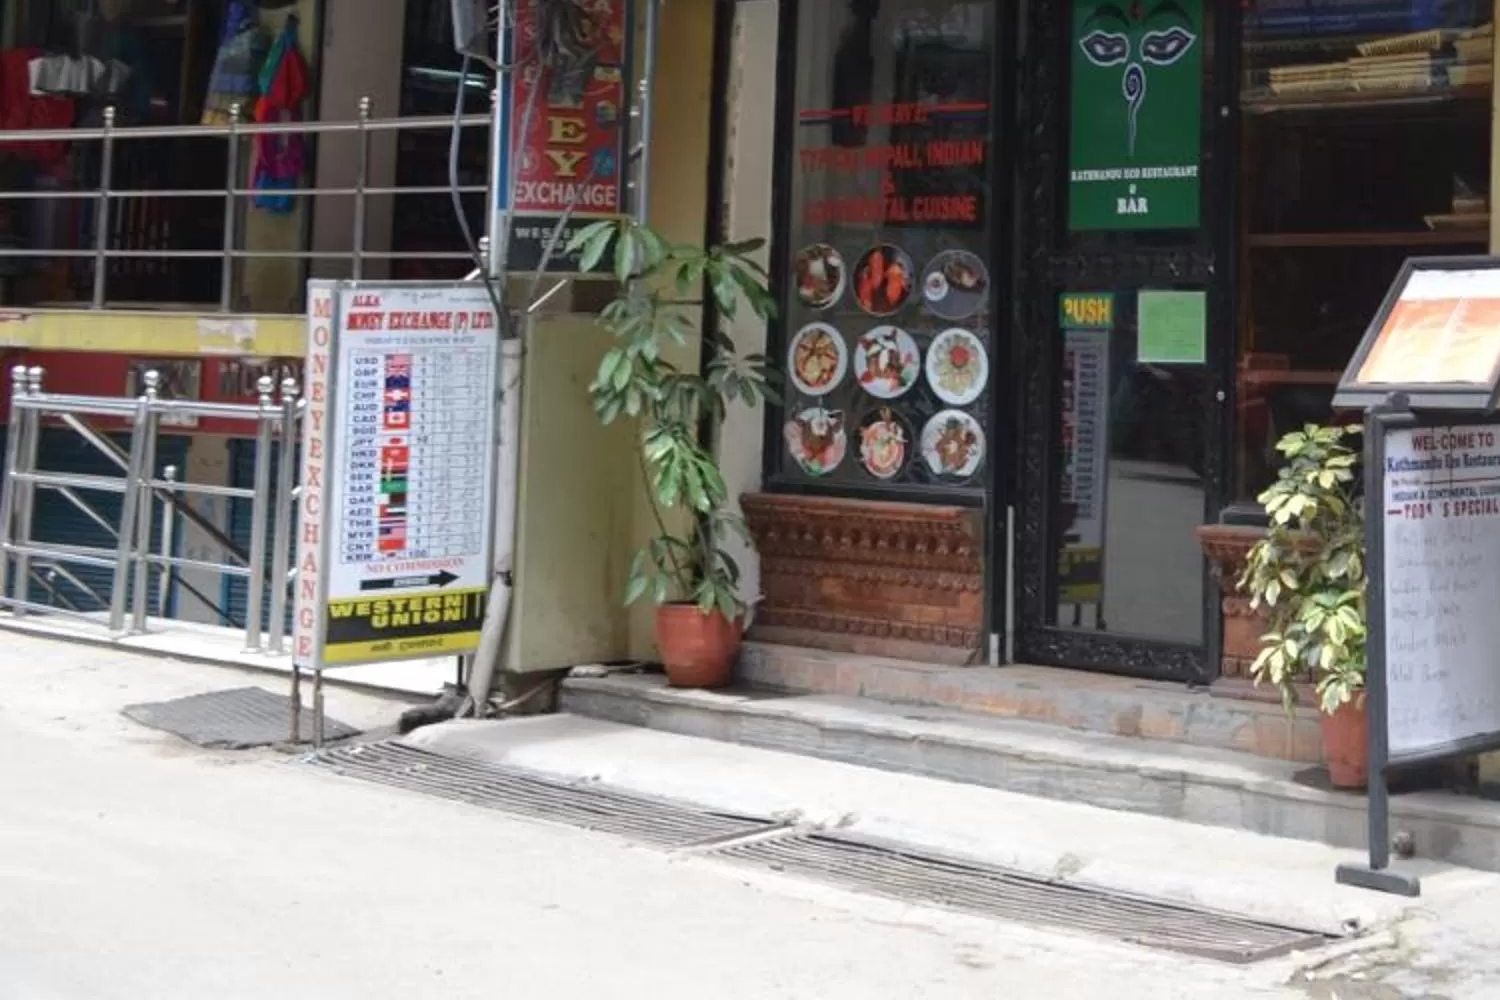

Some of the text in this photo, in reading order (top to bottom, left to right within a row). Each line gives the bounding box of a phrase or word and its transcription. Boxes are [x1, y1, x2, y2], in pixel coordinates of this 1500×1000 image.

[514, 180, 617, 206] EXCHANGE
[1116, 197, 1149, 214] BAR
[1063, 297, 1110, 325] PUSH
[330, 594, 462, 618] WESTERN
[371, 607, 462, 629] UNION
